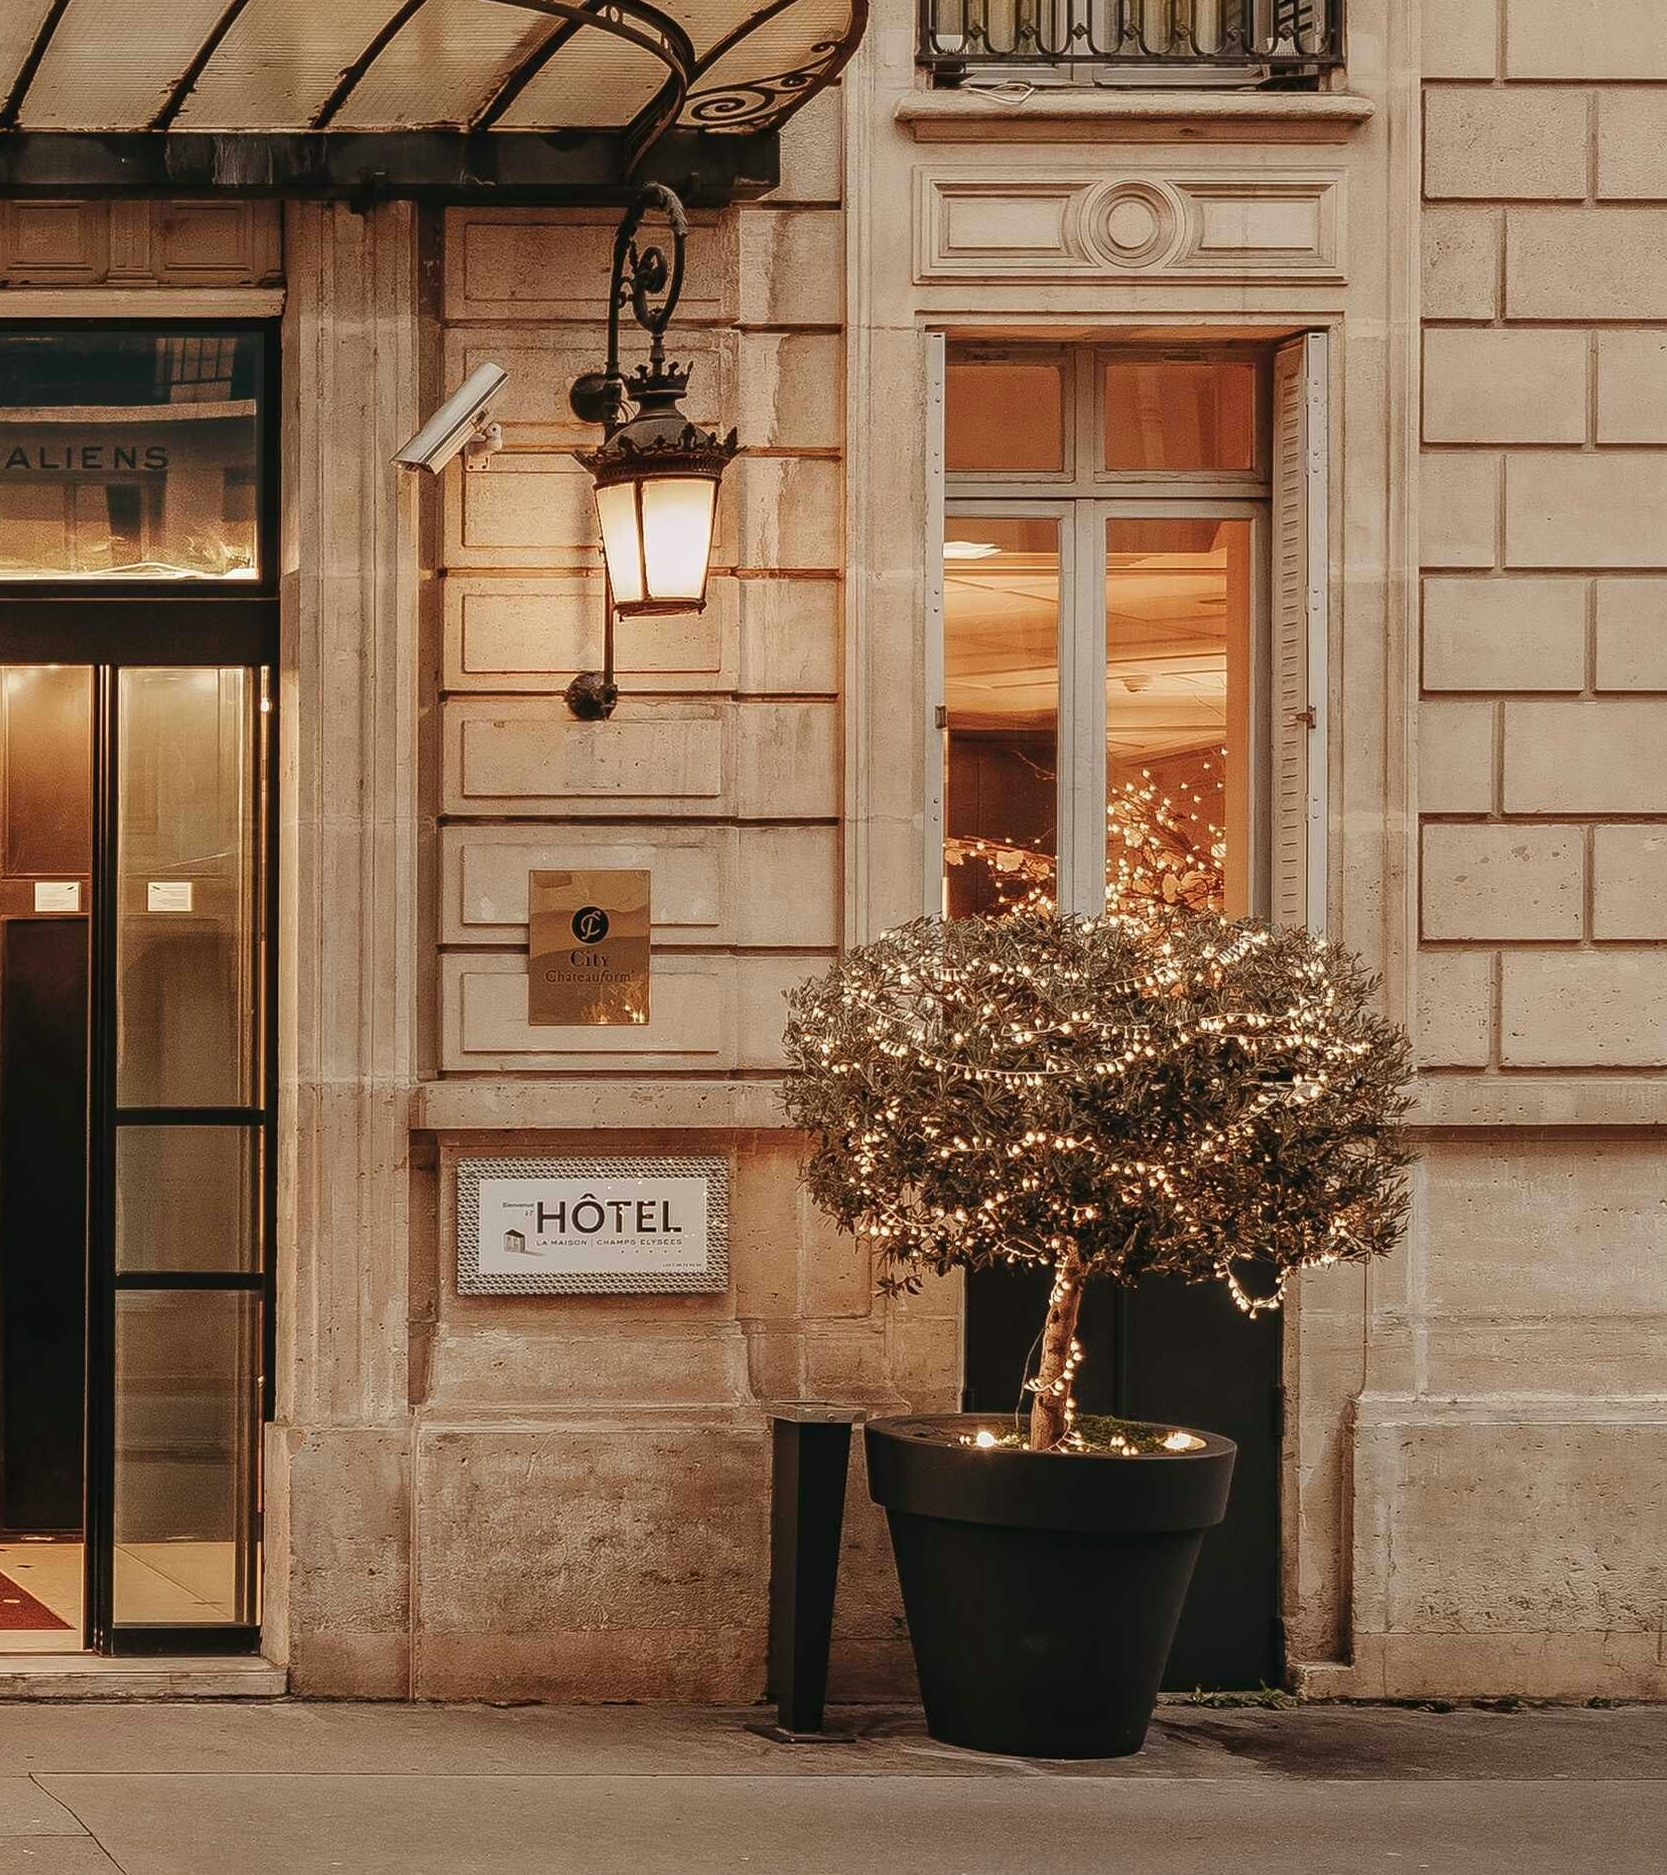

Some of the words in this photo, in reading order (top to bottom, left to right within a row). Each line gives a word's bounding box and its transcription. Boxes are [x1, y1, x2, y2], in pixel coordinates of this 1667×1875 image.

[570, 951, 610, 967] City
[536, 1192, 682, 1234] HÔTEL
[535, 1239, 548, 1247] LA
[550, 1239, 588, 1247] MAISON
[596, 1239, 637, 1247] CHAMPS
